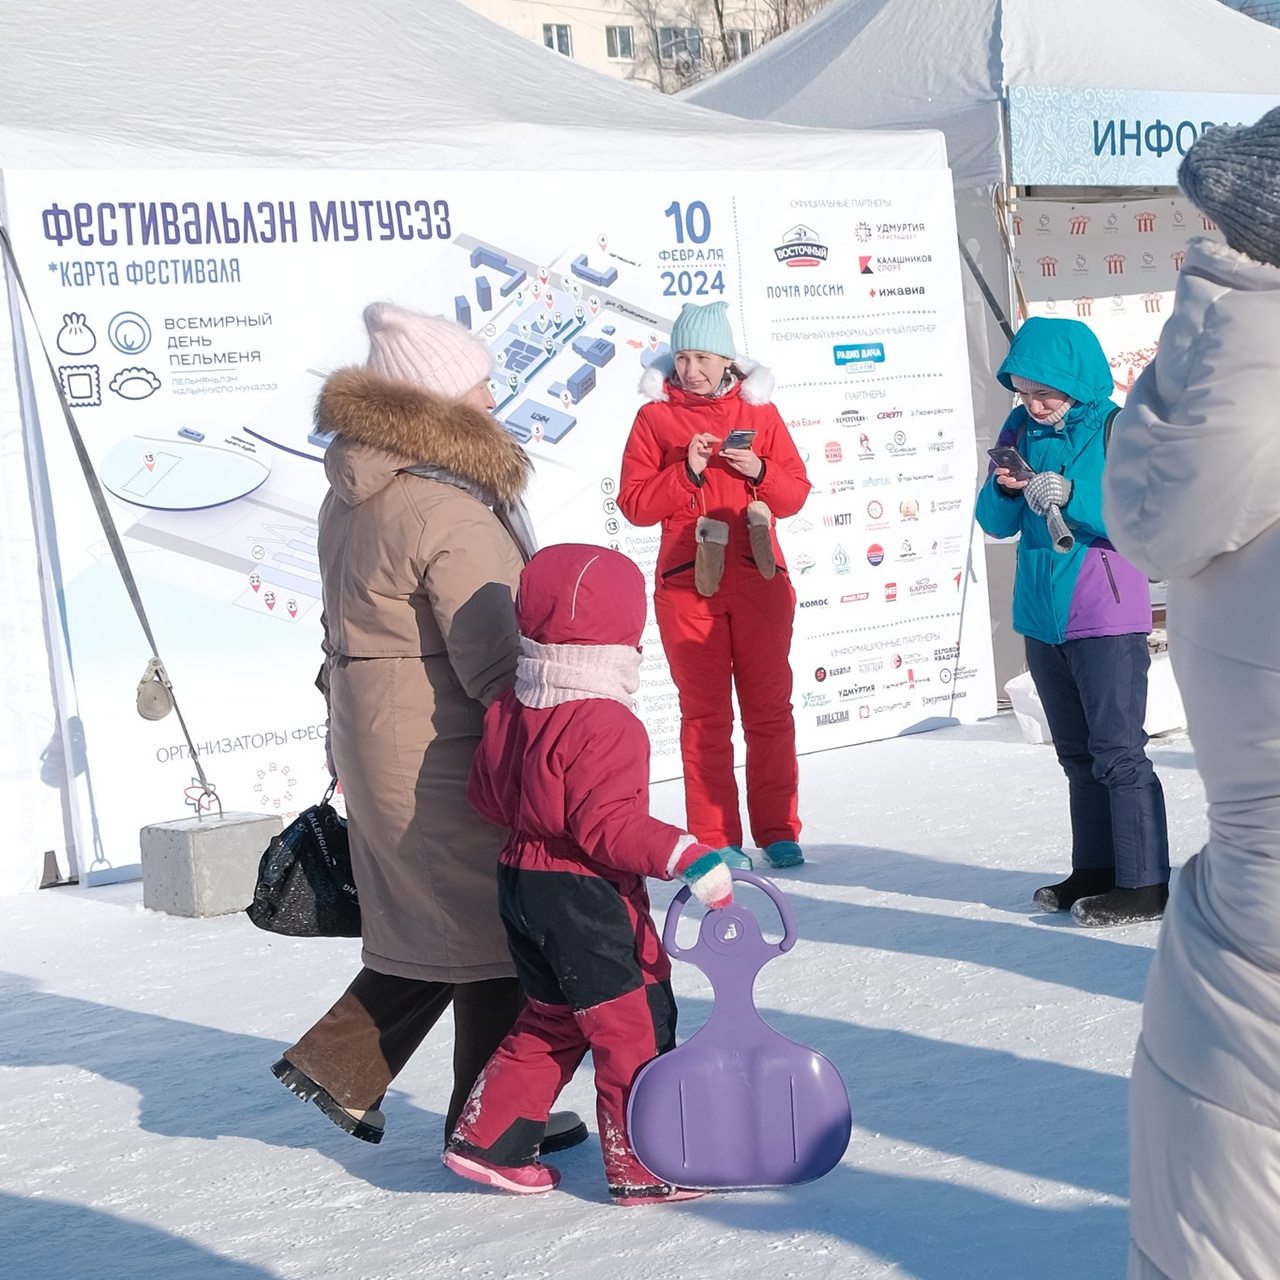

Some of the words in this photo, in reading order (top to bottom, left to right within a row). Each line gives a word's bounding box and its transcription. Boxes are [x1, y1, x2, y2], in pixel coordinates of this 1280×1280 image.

[664, 200, 711, 244] 10
[876, 223, 925, 233] УДМУРТИЯ
[658, 248, 724, 262] ФЕВРАЛЯ
[776, 244, 828, 260] ВОСТОЧНЫЙ
[877, 254, 933, 265] КАЛАШНИКОВ
[126, 258, 242, 285] ФЕСТИВАЛЯ
[877, 264, 901, 272] СПОРТ
[660, 270, 726, 297] 2024
[767, 285, 801, 299] ПОЧТА
[804, 283, 845, 297] РОССИИ
[164, 312, 273, 330] ВСЕМИРНЫЙ
[167, 334, 213, 350] ДЕНЬ
[169, 351, 262, 367] ПЕЛЬМЕНЯ
[836, 349, 860, 360] РАДИО
[861, 348, 882, 358] ДАЧА
[845, 390, 886, 400] ПАРТНЕРЫ
[800, 599, 829, 609] КОМОС
[902, 632, 940, 645] ПАРТНЕРЫ
[292, 723, 327, 741] ФЕС
